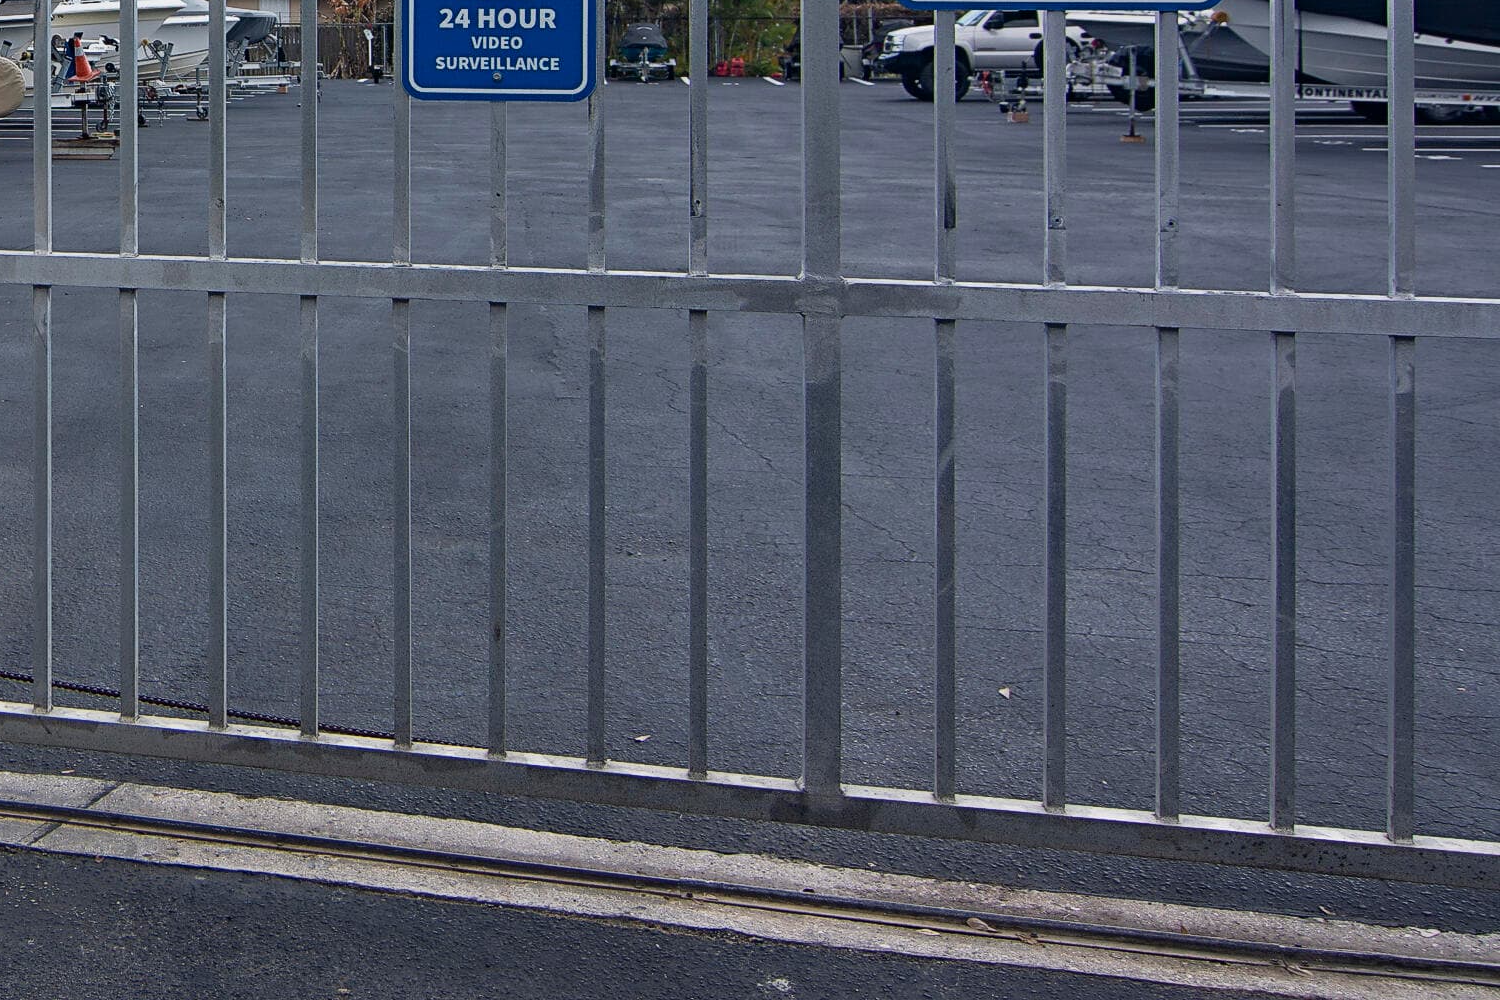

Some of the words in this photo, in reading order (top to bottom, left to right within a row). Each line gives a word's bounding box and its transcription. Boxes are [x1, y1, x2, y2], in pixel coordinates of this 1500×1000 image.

[439, 8, 471, 29] 24
[478, 8, 557, 29] HOUR
[471, 36, 523, 50] VIDEO
[435, 56, 560, 71] SURVEILLANCE
